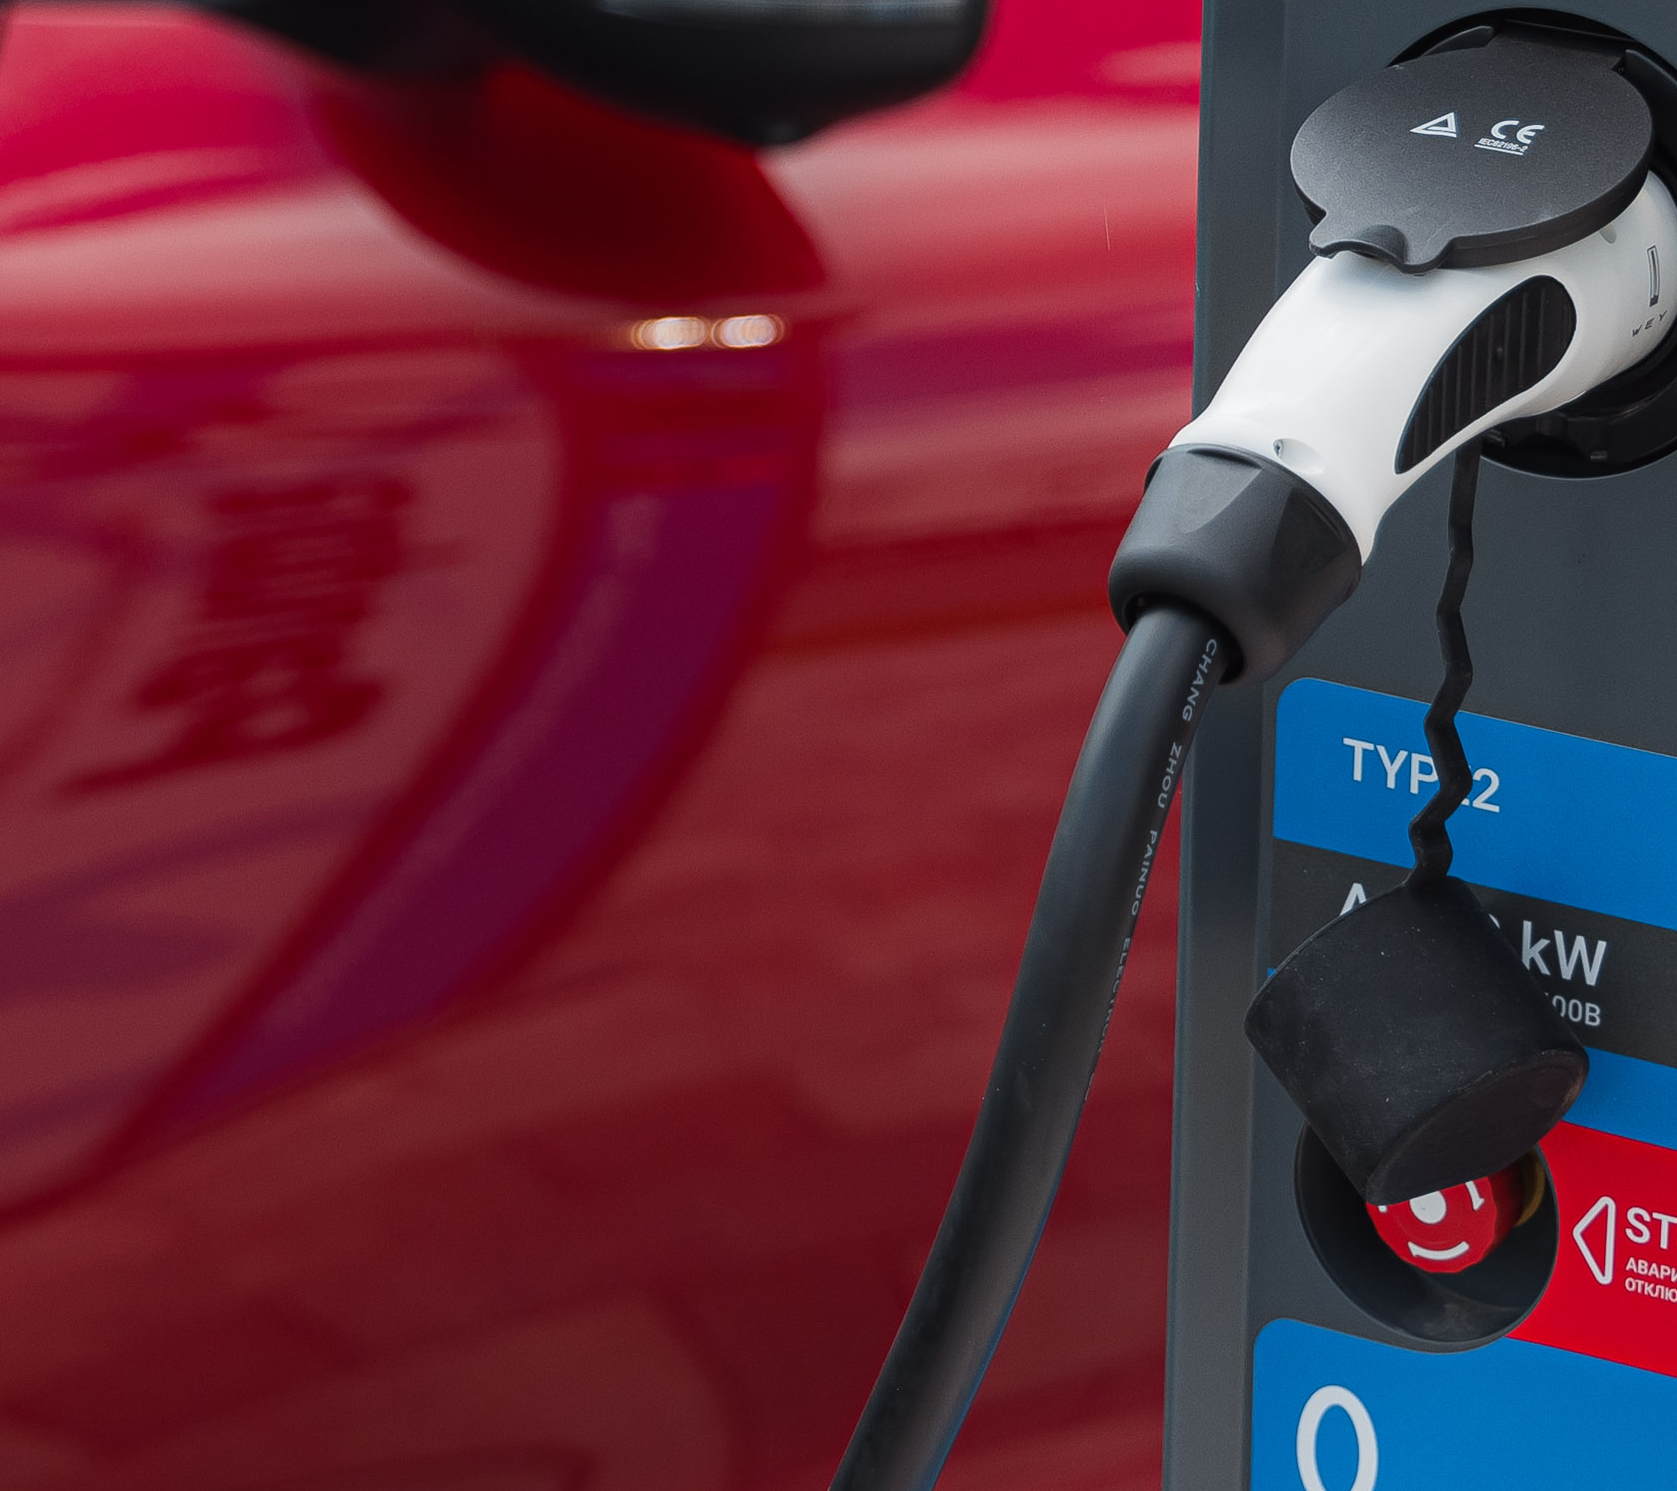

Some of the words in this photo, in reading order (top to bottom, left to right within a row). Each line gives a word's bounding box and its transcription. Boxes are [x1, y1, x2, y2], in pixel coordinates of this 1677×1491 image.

[1632, 310, 1667, 337] WEY
[1182, 638, 1218, 722] CHANG
[1158, 741, 1182, 809] ZHOU
[1342, 737, 1470, 806] TYP
